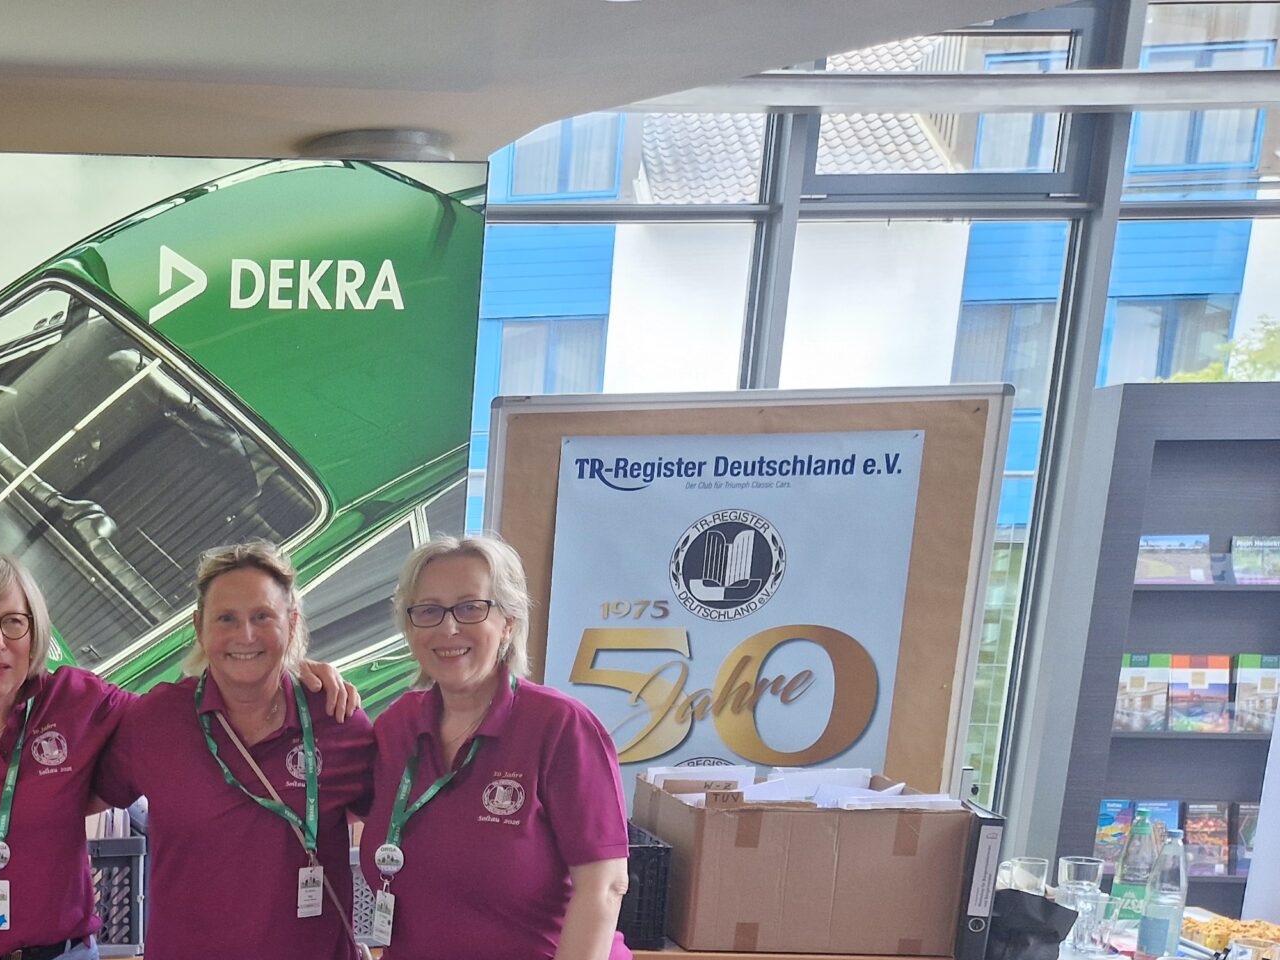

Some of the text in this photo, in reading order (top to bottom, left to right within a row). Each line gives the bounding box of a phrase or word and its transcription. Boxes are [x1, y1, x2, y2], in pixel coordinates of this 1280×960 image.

[230, 259, 405, 309] DEKRA
[575, 453, 902, 491] TR-Register Deutschland e.V.
[685, 482, 697, 490] Der
[698, 481, 712, 490] Club
[724, 481, 750, 491] Triumph
[751, 480, 773, 489] Classic
[692, 511, 770, 534] TR-REGISTER
[599, 600, 670, 620] 1975
[678, 591, 758, 620] DEUTSCHLAND
[608, 655, 816, 757] Jahre
